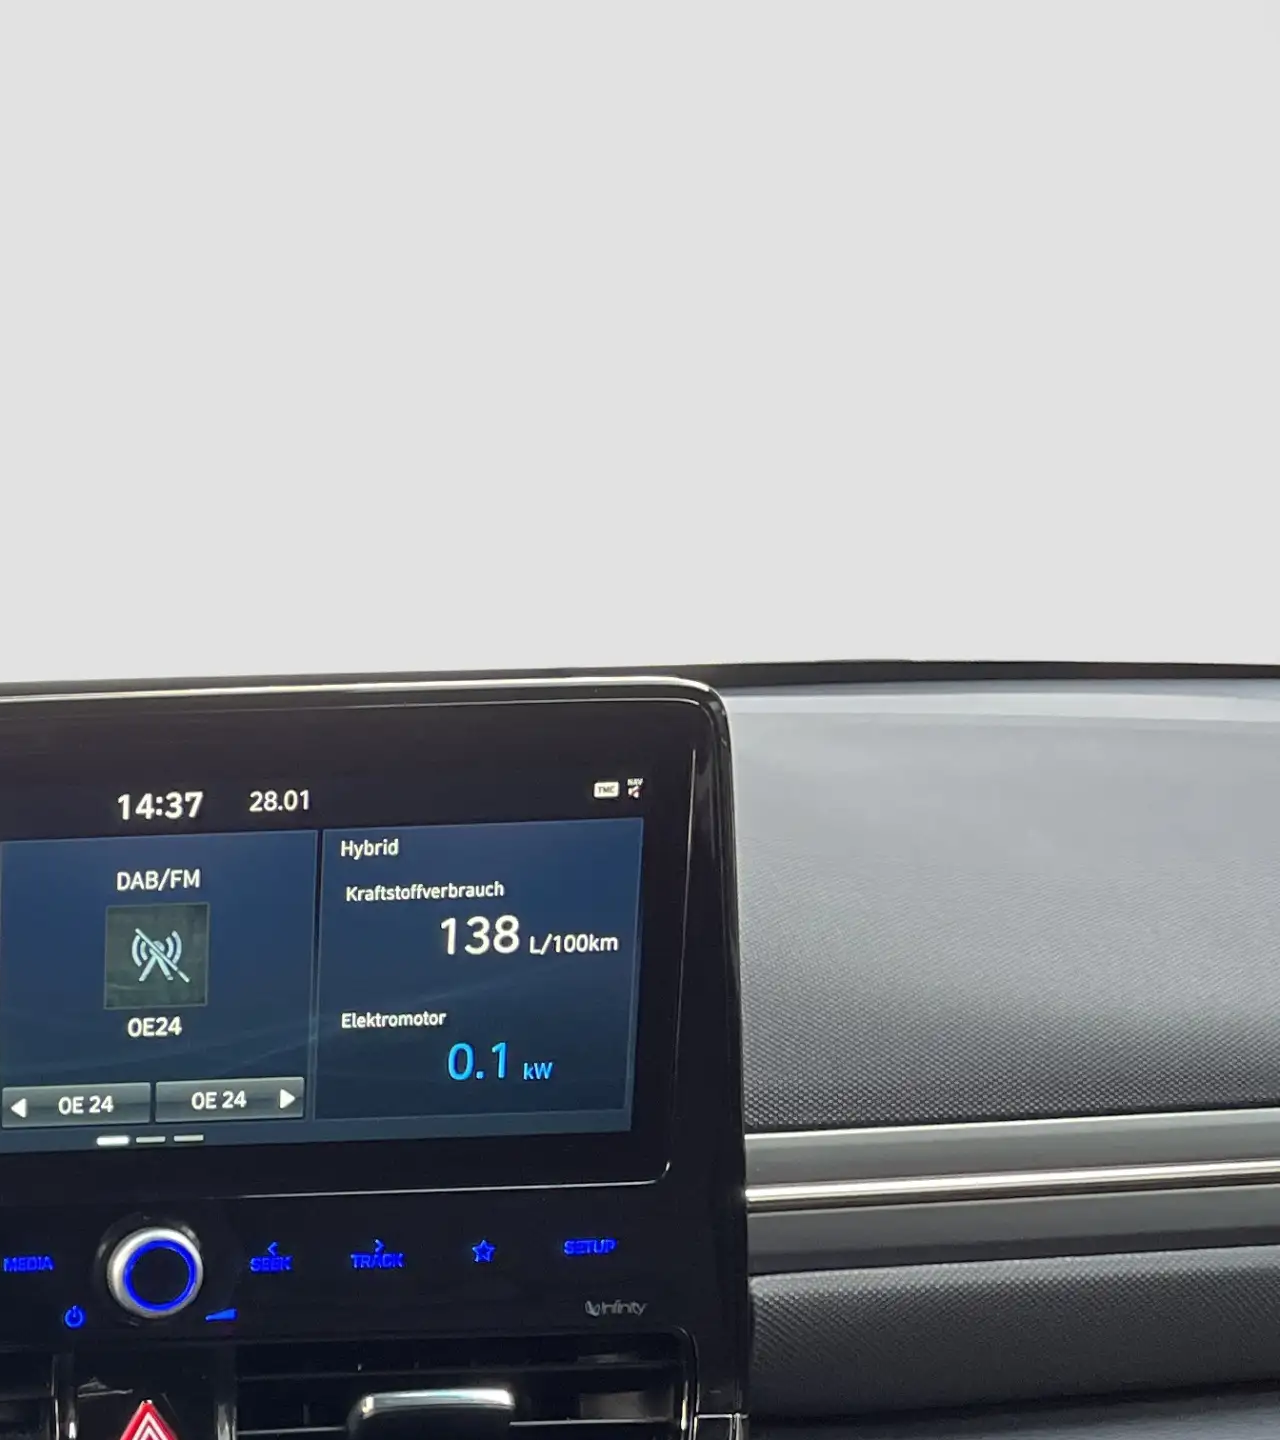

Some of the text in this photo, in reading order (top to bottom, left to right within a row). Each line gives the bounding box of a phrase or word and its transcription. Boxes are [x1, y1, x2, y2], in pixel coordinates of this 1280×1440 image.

[116, 791, 204, 821] 14:37
[248, 789, 311, 813] 28.01
[340, 838, 399, 859] Hybrid
[116, 869, 201, 891] DAB/FM
[345, 880, 505, 901] Kraftstoffverbrauch
[440, 915, 619, 956] 138 L/100km
[341, 1009, 447, 1029] Elektromotor
[447, 1043, 552, 1081] 0.1 kW
[89, 1096, 114, 1113] 24
[222, 1091, 247, 1108] 24
[564, 1238, 618, 1256] SETUP
[3, 1255, 54, 1273] MEDIA
[250, 1255, 294, 1273] SEEK
[351, 1252, 404, 1269] TRACK
